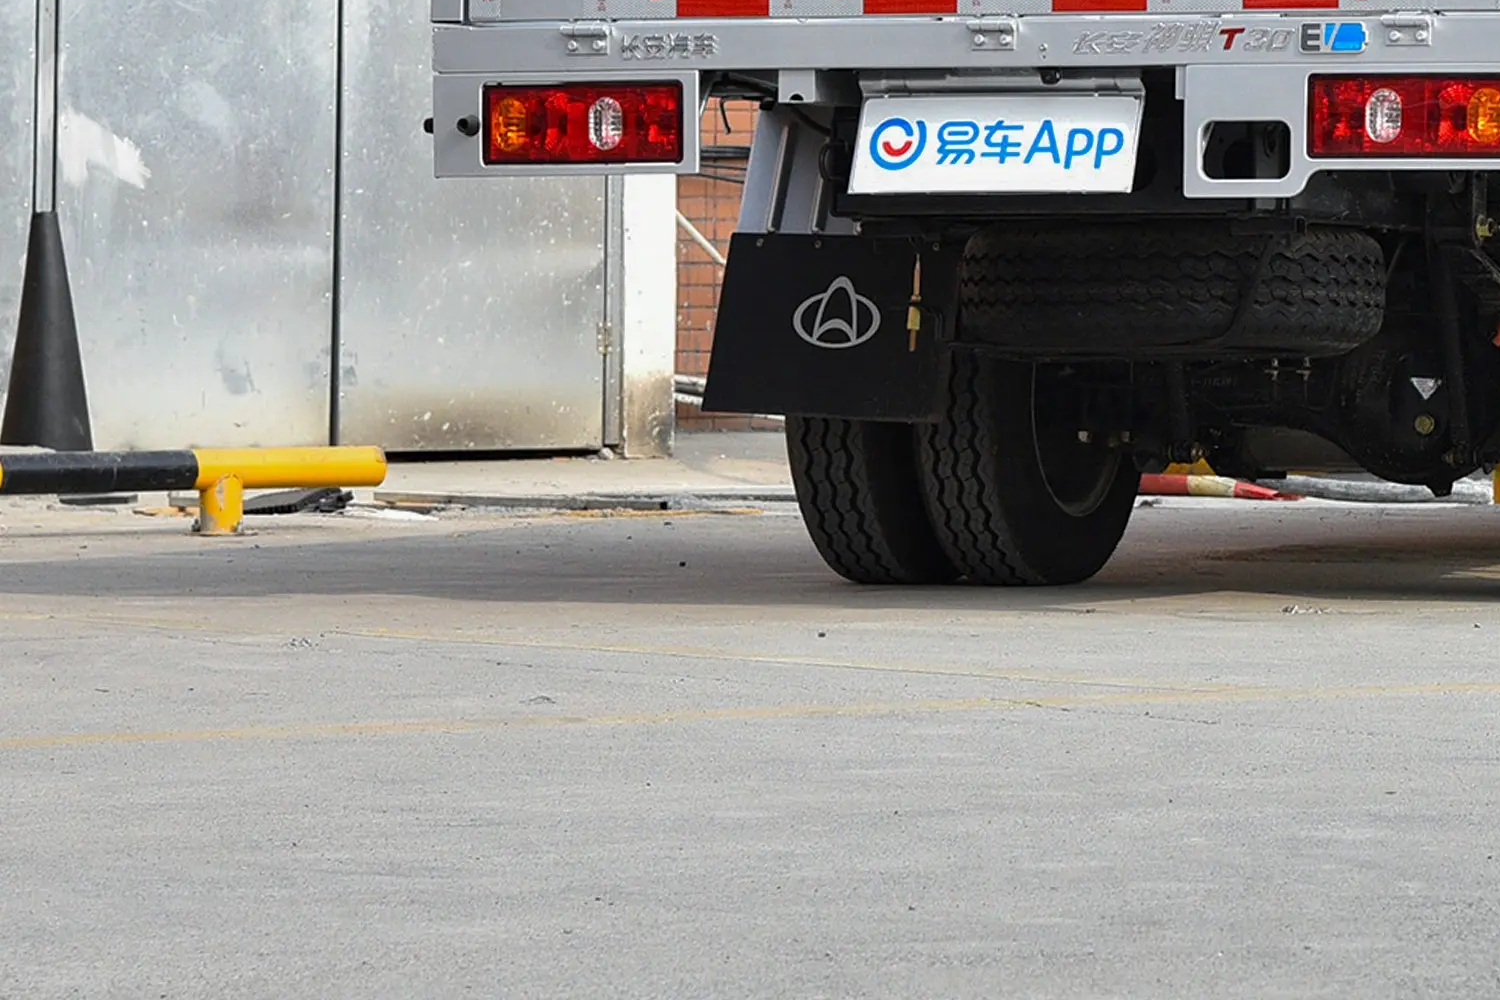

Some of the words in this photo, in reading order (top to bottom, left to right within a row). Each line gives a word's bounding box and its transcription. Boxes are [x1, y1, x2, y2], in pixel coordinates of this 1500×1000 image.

[620, 32, 719, 61] 长安汽车
[936, 119, 1124, 170] 易车App
